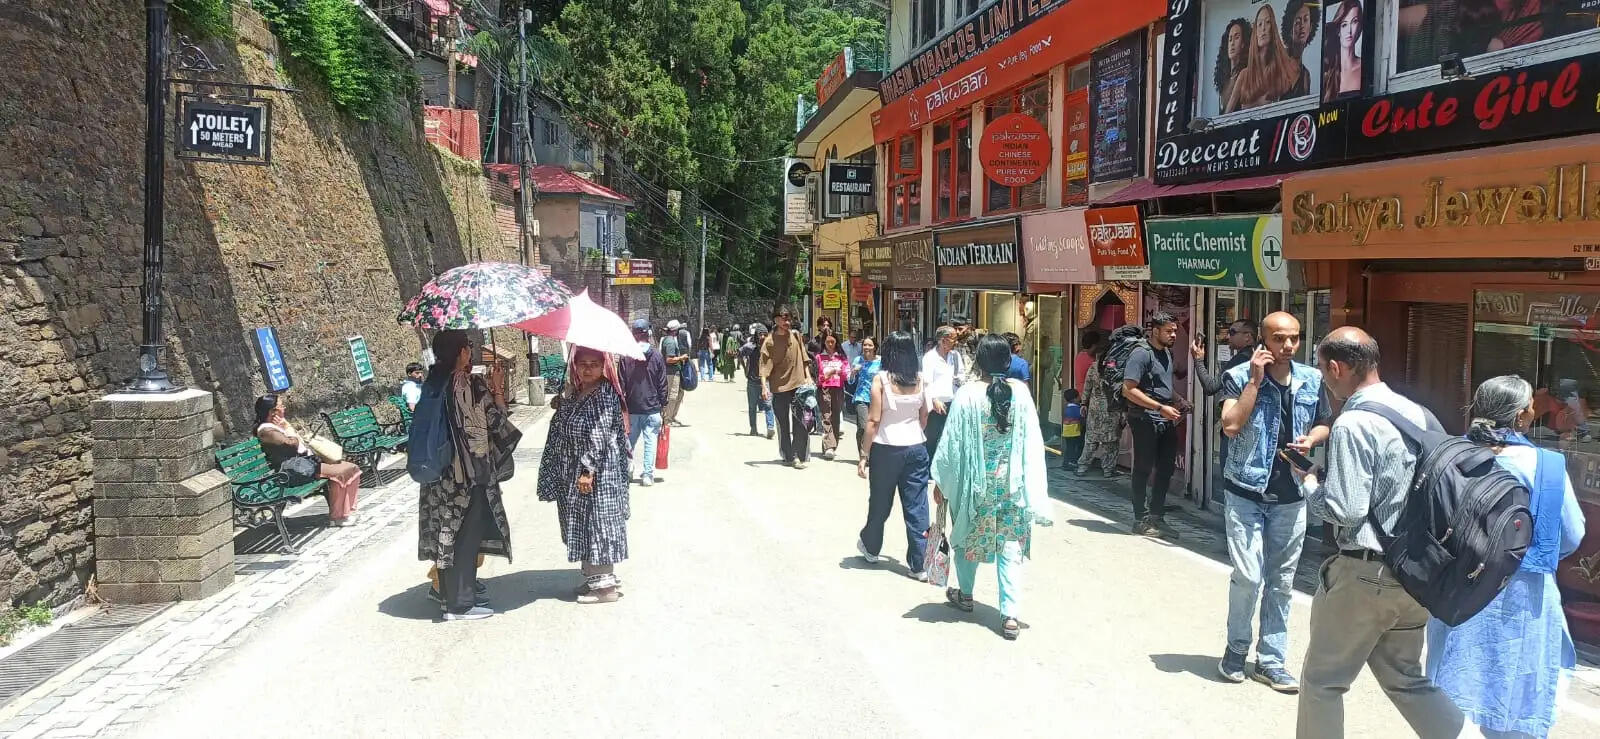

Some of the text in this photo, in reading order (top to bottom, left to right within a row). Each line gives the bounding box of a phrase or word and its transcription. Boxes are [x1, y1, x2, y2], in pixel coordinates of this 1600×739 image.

[912, 22, 977, 82] TOBACCOS
[925, 66, 988, 120] pakwaan
[1361, 61, 1582, 138] Cute Girl
[196, 113, 249, 132] TOILET
[200, 130, 245, 144] 50 METERS
[211, 141, 234, 149] AHEAD
[991, 130, 1041, 144] pakwaan
[1156, 128, 1261, 170] Deecent
[1206, 155, 1260, 174] MEN'S SALON
[831, 181, 871, 193] RESTAURANT
[1004, 176, 1026, 184] FOOD
[1291, 189, 1404, 247] Satya
[1089, 214, 1137, 247] pakwaan
[1153, 231, 1247, 252] Pacific Chemist
[1582, 244, 1592, 253] THE
[936, 242, 1013, 266] INDIAN TERRAIN
[1177, 257, 1221, 270] PHARMACY
